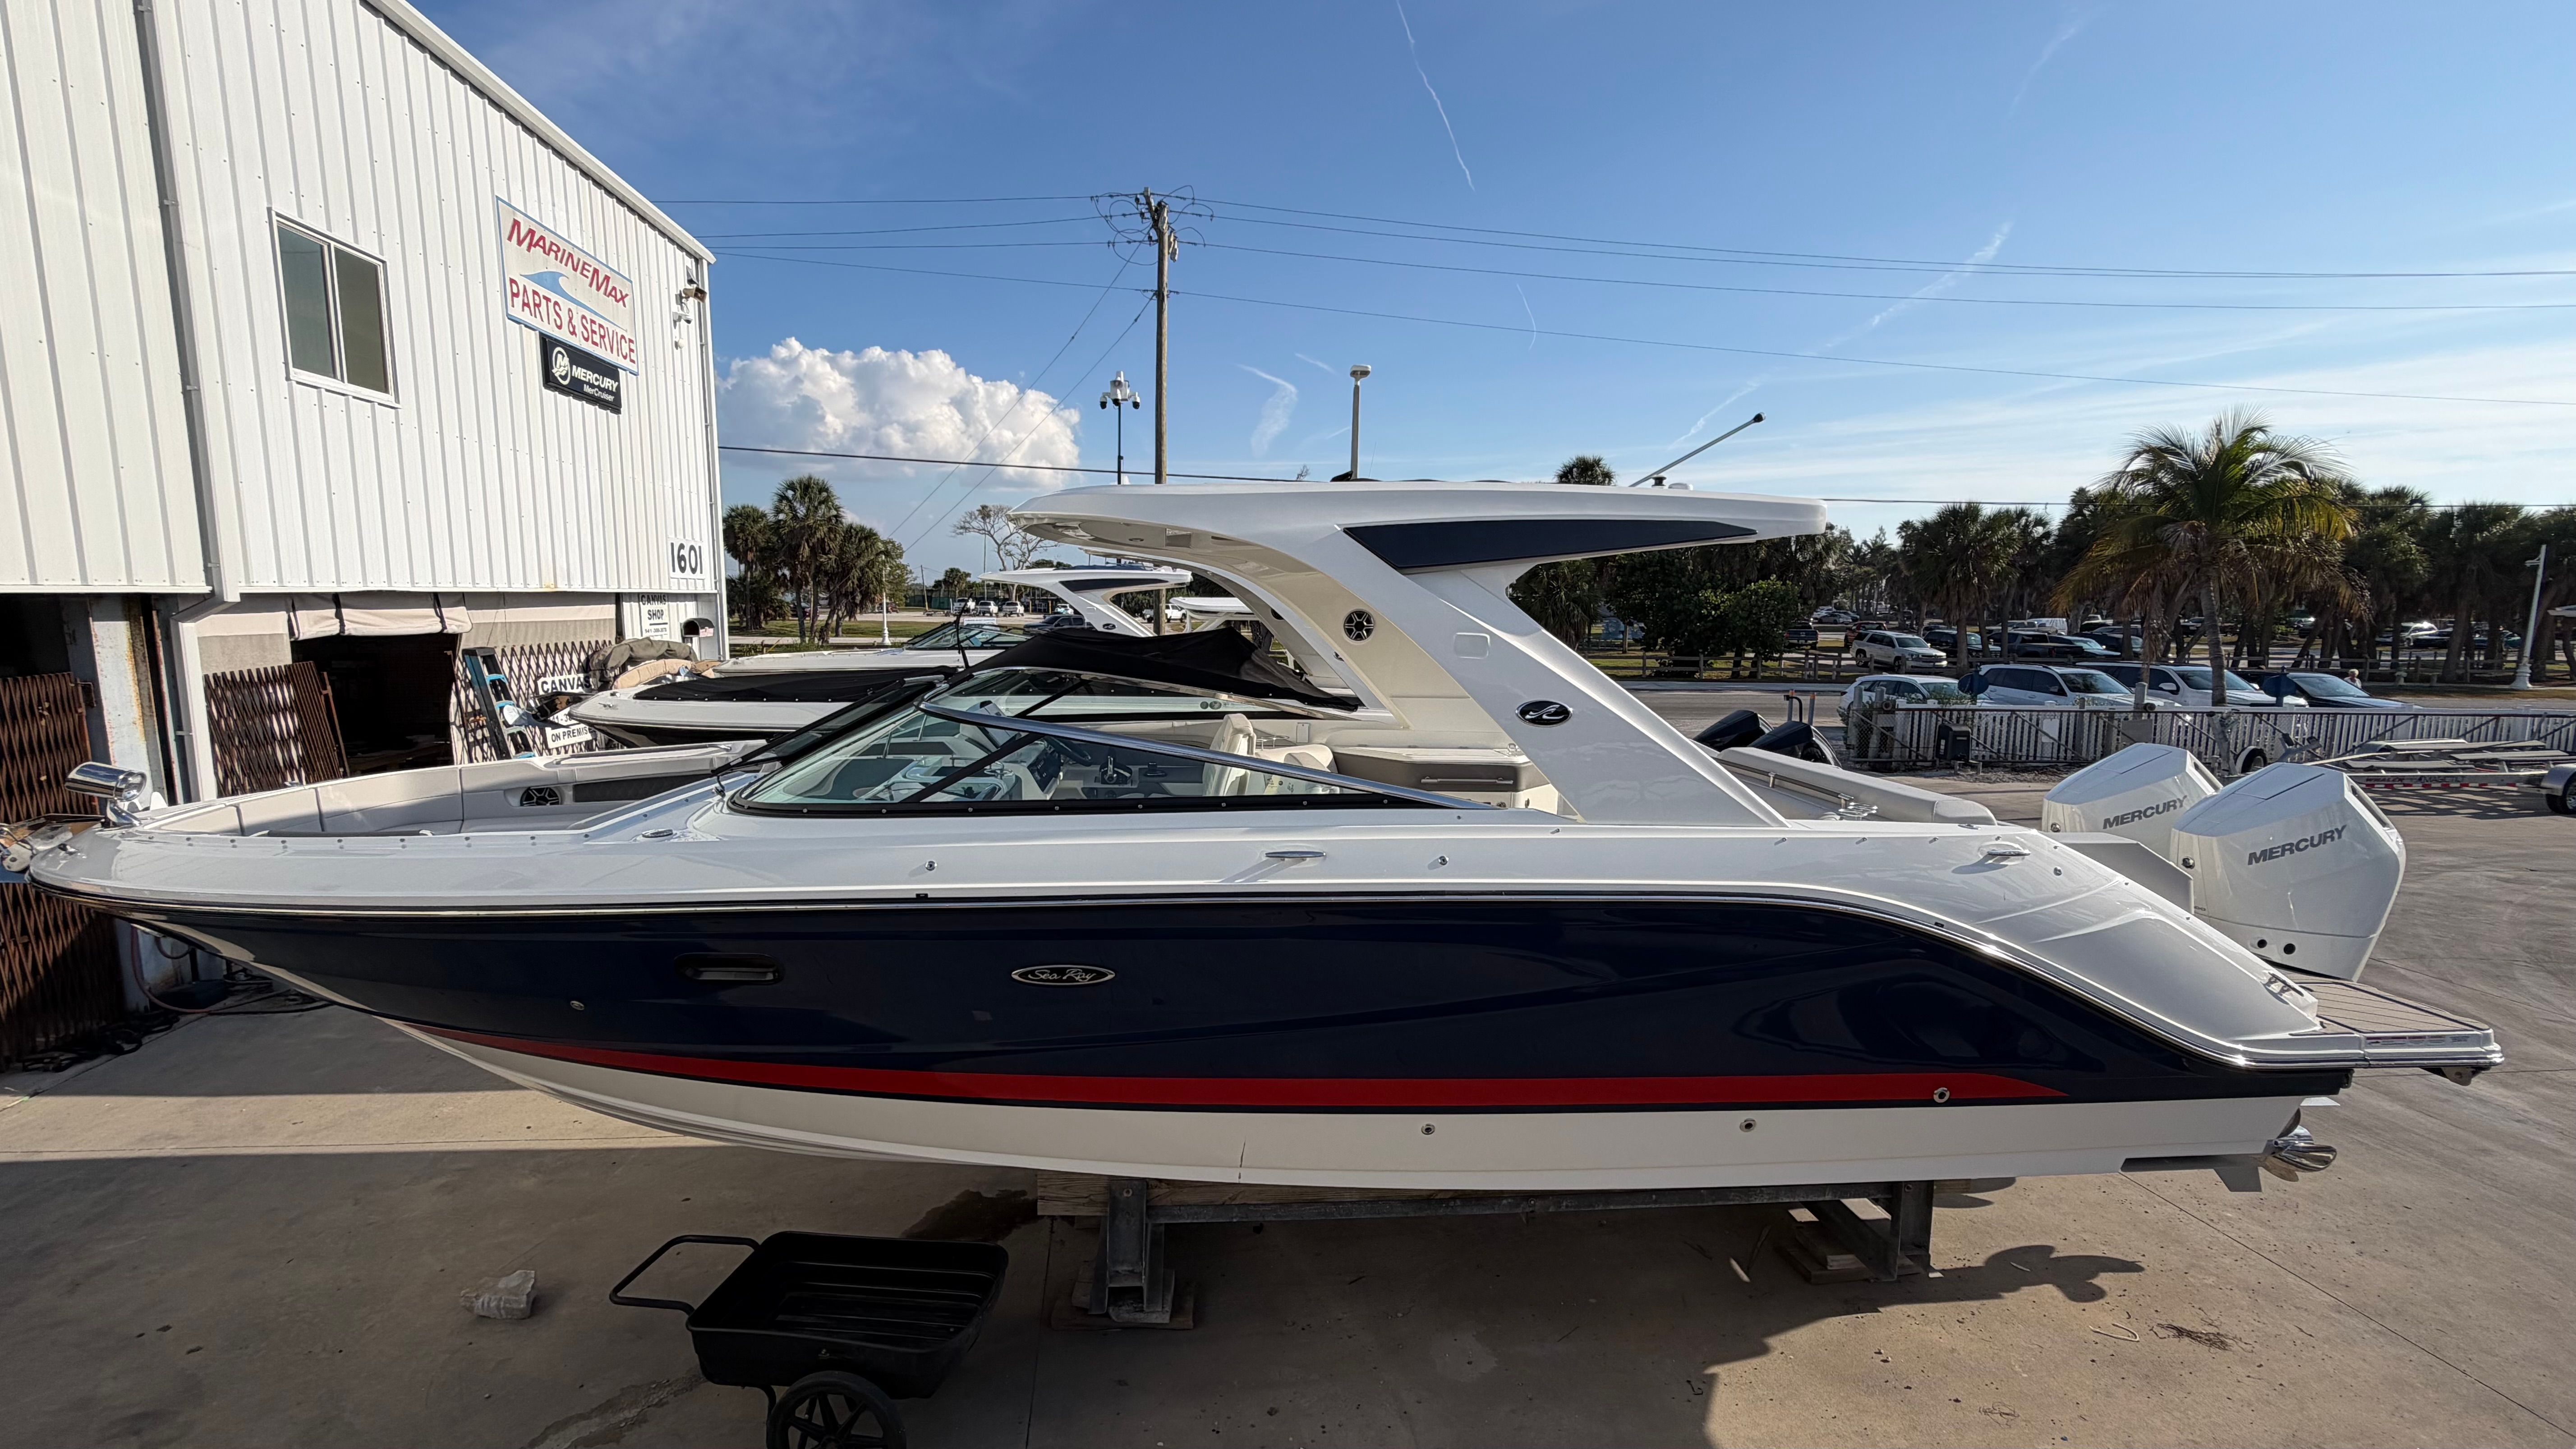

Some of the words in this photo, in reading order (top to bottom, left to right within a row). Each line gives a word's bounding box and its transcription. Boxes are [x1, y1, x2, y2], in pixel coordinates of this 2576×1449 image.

[509, 277, 562, 330] PARTS
[567, 308, 577, 337] &
[581, 313, 636, 364] SERVICE
[572, 365, 618, 392] MERCURY
[584, 384, 614, 402] MerCruiser
[671, 542, 703, 575] 1601
[641, 594, 666, 605] CANVAS
[648, 609, 664, 621] SHOP
[541, 676, 590, 693] CANVAS
[551, 732, 561, 742] ON
[2102, 795, 2187, 829] MERCURY
[2248, 824, 2347, 865] MERCURY
[1028, 970, 1061, 980] Sea
[1063, 969, 1096, 982] Ray
